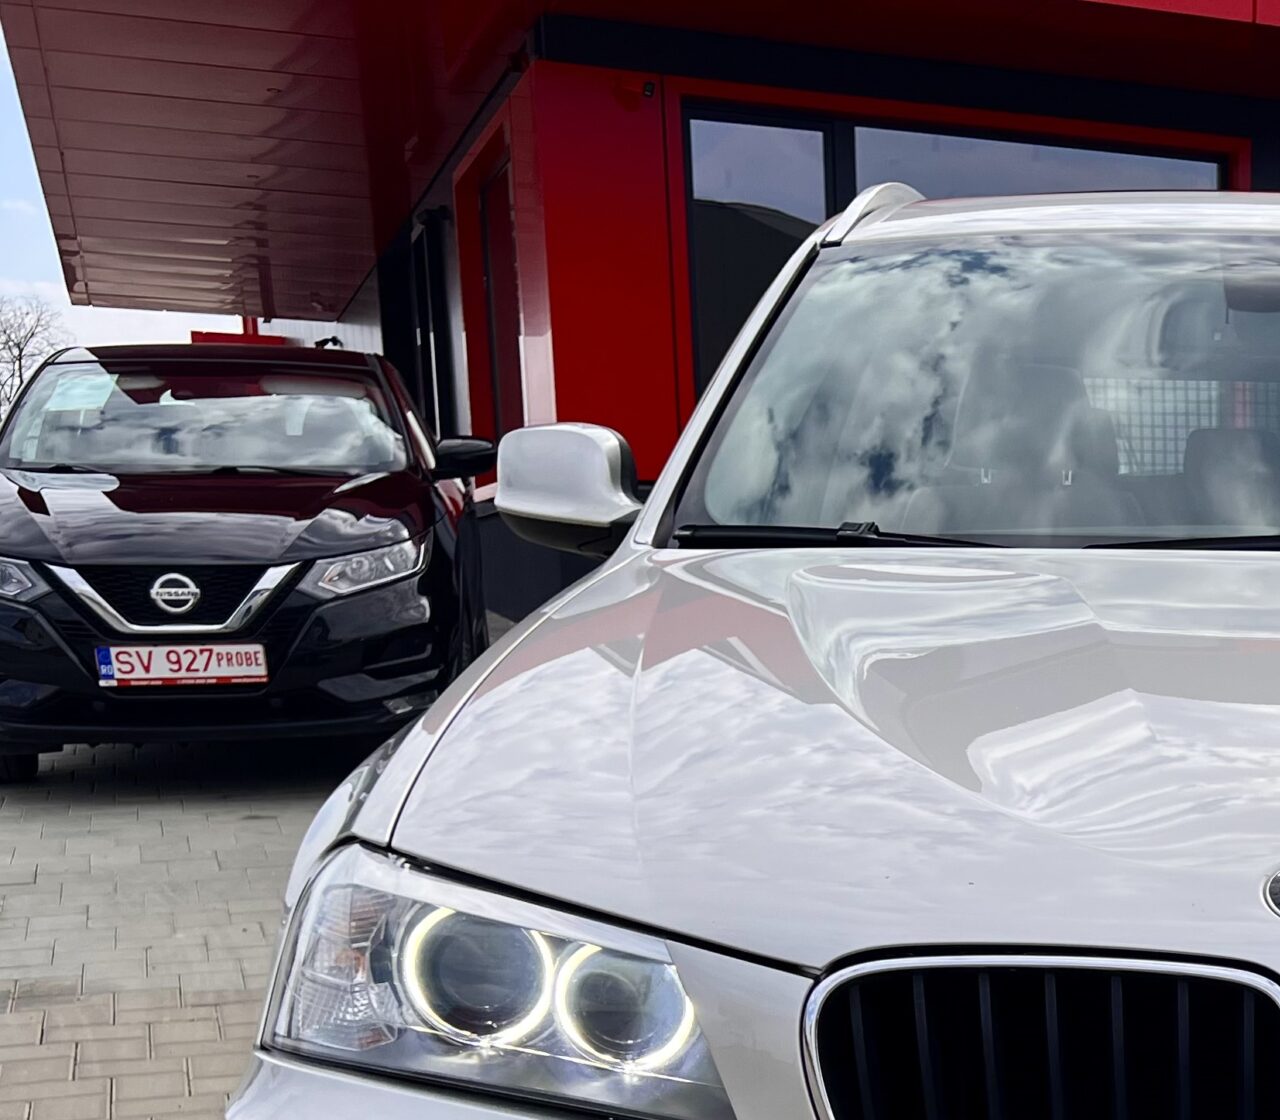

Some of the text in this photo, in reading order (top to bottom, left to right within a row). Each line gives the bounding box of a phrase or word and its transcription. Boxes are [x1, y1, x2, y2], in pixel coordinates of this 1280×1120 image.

[115, 648, 263, 675] SV 927 PROBE
